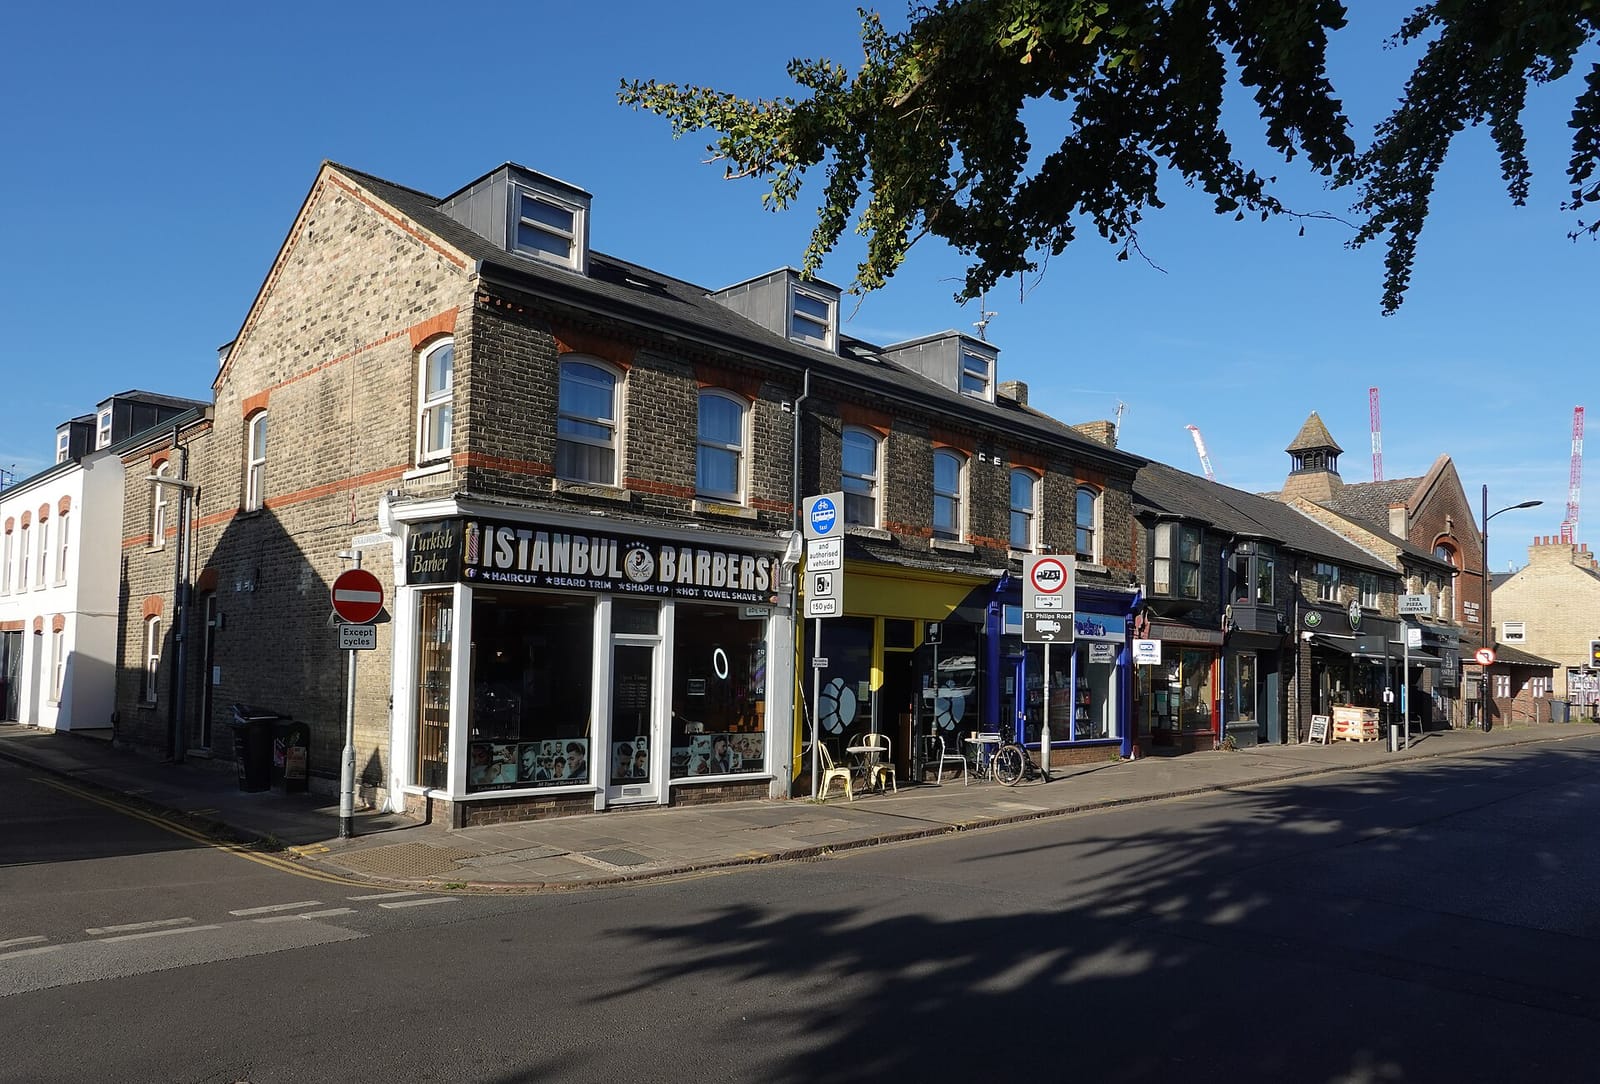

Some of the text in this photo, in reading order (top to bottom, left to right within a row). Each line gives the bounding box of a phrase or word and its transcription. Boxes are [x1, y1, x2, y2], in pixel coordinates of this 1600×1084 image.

[410, 528, 453, 552] Turkish
[483, 525, 770, 592] ISTANBUL BARBERS
[809, 550, 838, 559] authorised
[411, 553, 449, 574] Barber
[812, 559, 835, 568] vehicles
[491, 572, 757, 602] HAIRCUT BEARD TRIM SHAPE UP HOT TOWEL SHAVE
[823, 602, 833, 611] yds
[343, 628, 373, 637] Except
[343, 638, 371, 646] cycles
